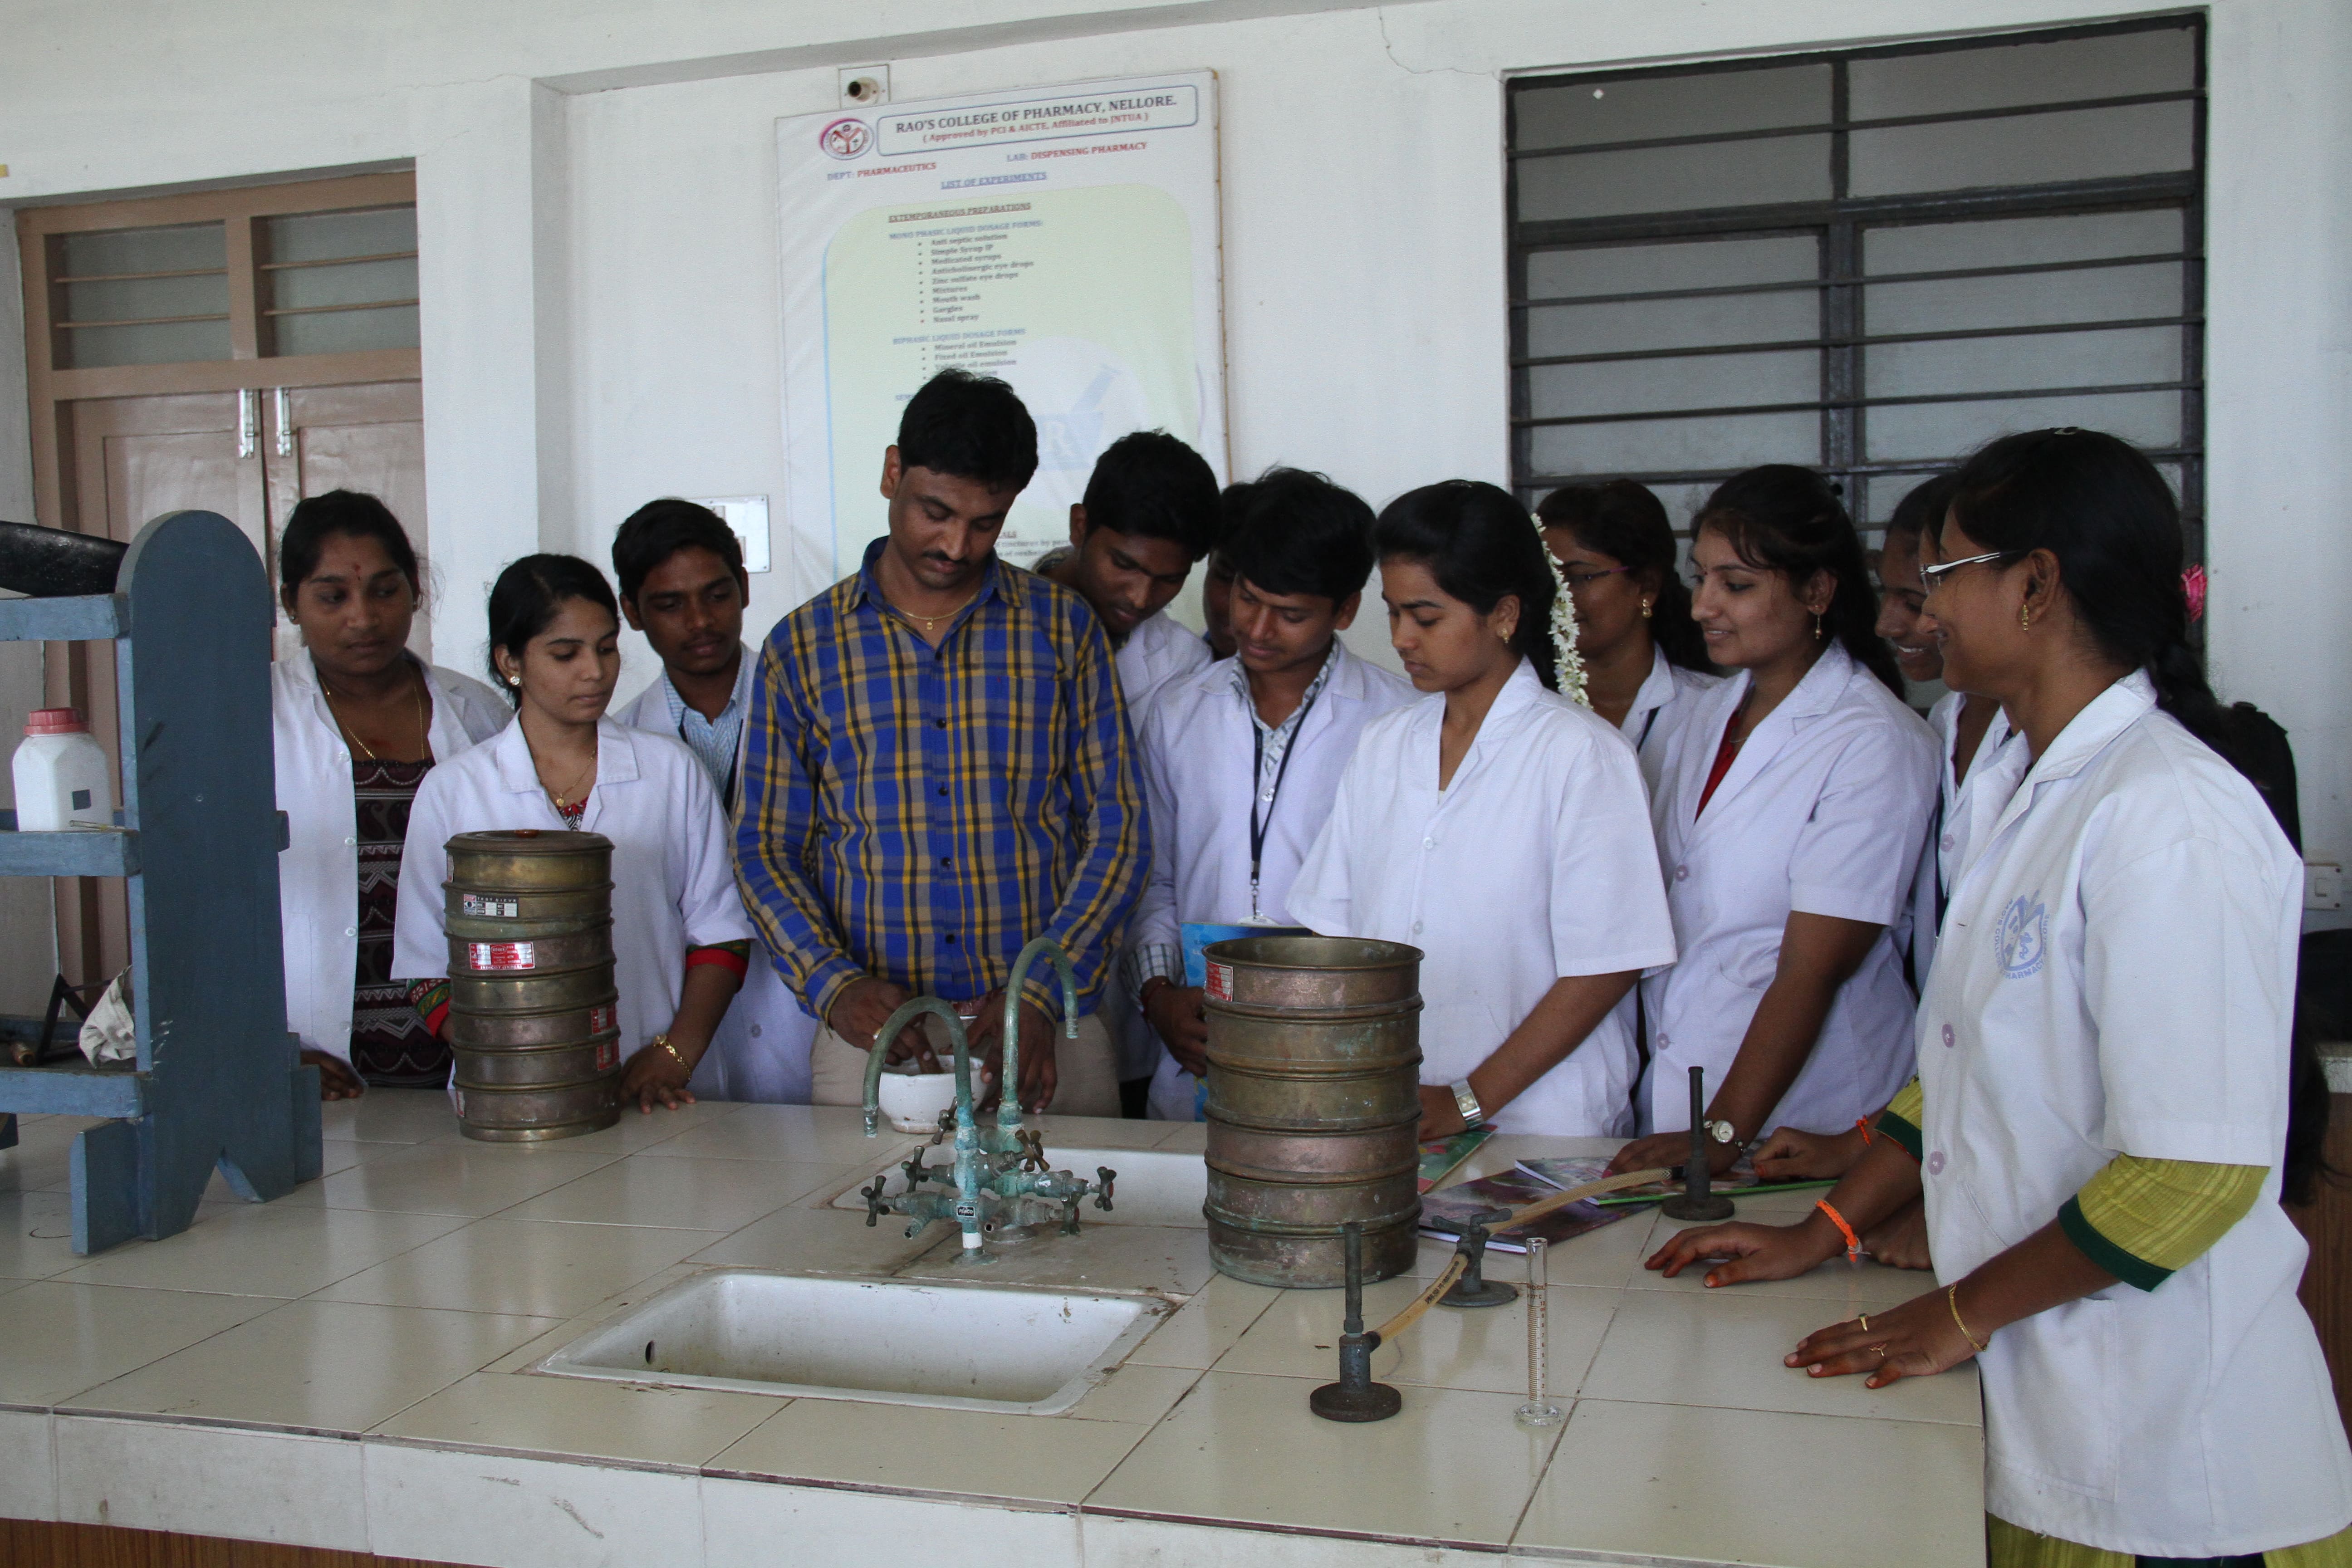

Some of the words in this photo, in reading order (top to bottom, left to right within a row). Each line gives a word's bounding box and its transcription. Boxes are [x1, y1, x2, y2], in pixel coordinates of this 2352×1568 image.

[896, 119, 935, 133] RAO'S
[938, 113, 998, 128] COLLEGE
[1002, 111, 1020, 122] OF
[1024, 102, 1106, 119] PHARMACY,
[1109, 95, 1177, 111] NELLORE.
[930, 130, 975, 142] Approved
[977, 127, 989, 137] by
[991, 126, 1006, 135] PCI
[1009, 125, 1016, 133] &
[1052, 118, 1096, 129] Affiliated
[1006, 153, 1028, 162] LAB:
[1031, 147, 1089, 160] DISPENSING
[1091, 142, 1147, 154] PHARMACY
[857, 162, 937, 177] PHARMACEUTICS
[941, 180, 961, 190] LIST
[964, 178, 977, 187] OF
[979, 172, 1047, 186] EXPERIMENTS
[888, 209, 965, 223] EXTEMPORANEOUS
[967, 202, 1031, 216] PREPARATIONS
